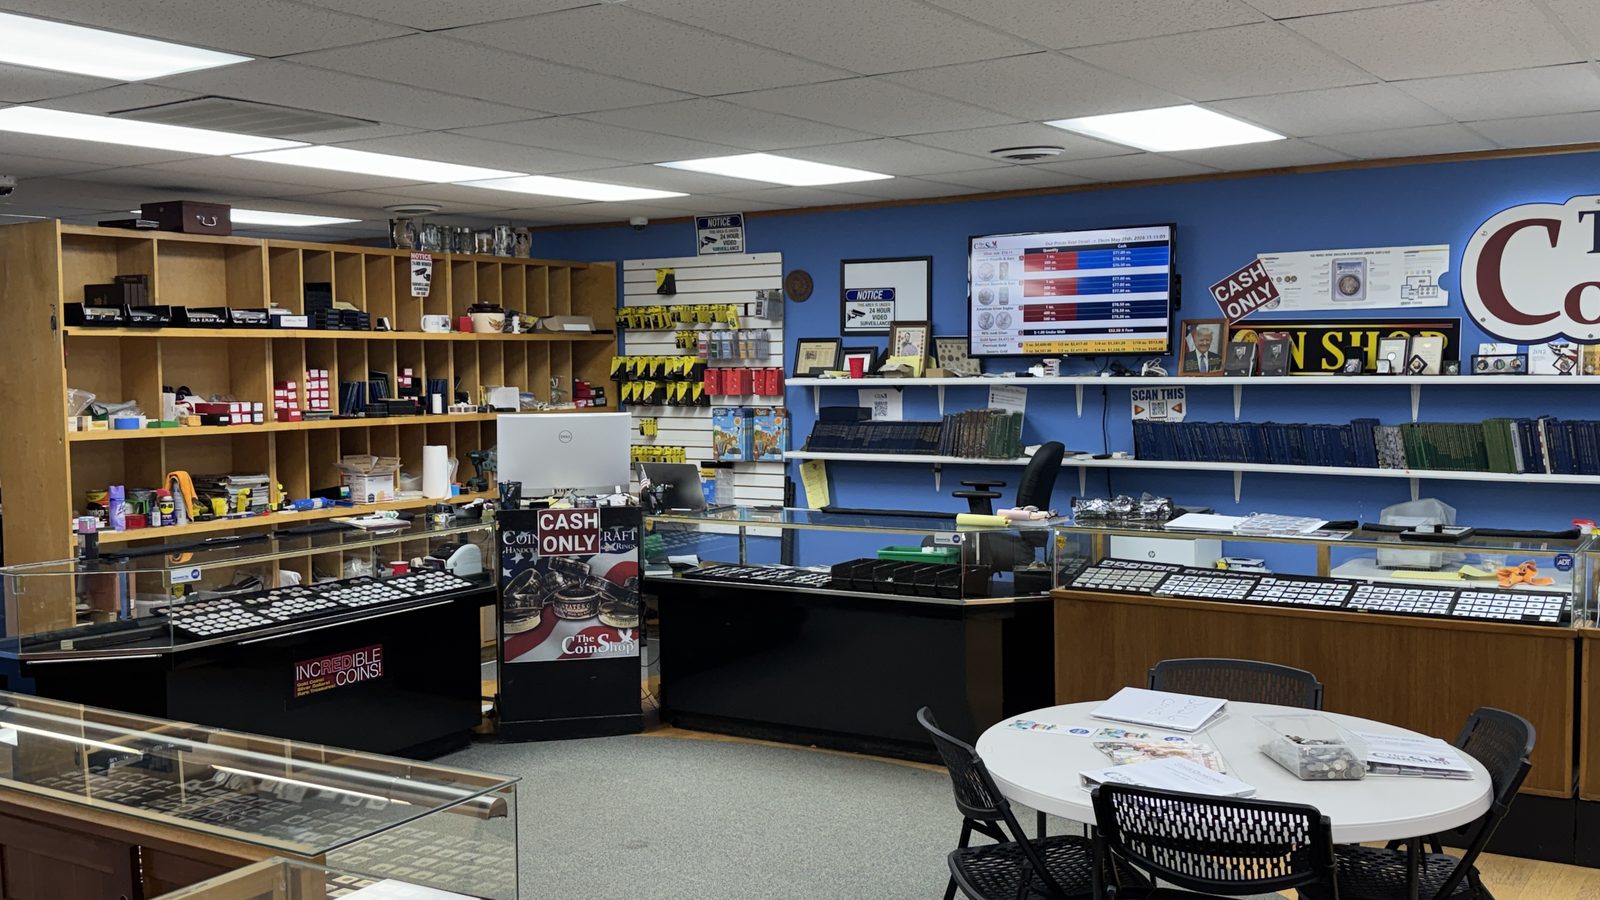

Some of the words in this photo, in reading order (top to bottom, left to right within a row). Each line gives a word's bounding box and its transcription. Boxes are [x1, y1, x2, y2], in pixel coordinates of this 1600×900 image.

[708, 217, 730, 228] NOTICE
[411, 252, 432, 260] NOTICE
[1214, 263, 1266, 302] CASH
[856, 290, 884, 300] NOTICE
[1226, 282, 1272, 318] ONLY
[1132, 389, 1158, 401] SCAN
[1160, 388, 1184, 400] THIS
[540, 513, 598, 531] CASH
[543, 534, 596, 552] ONLY
[576, 634, 594, 642] The
[296, 648, 381, 681] INCREDIBLE
[336, 662, 382, 686] COINS!
